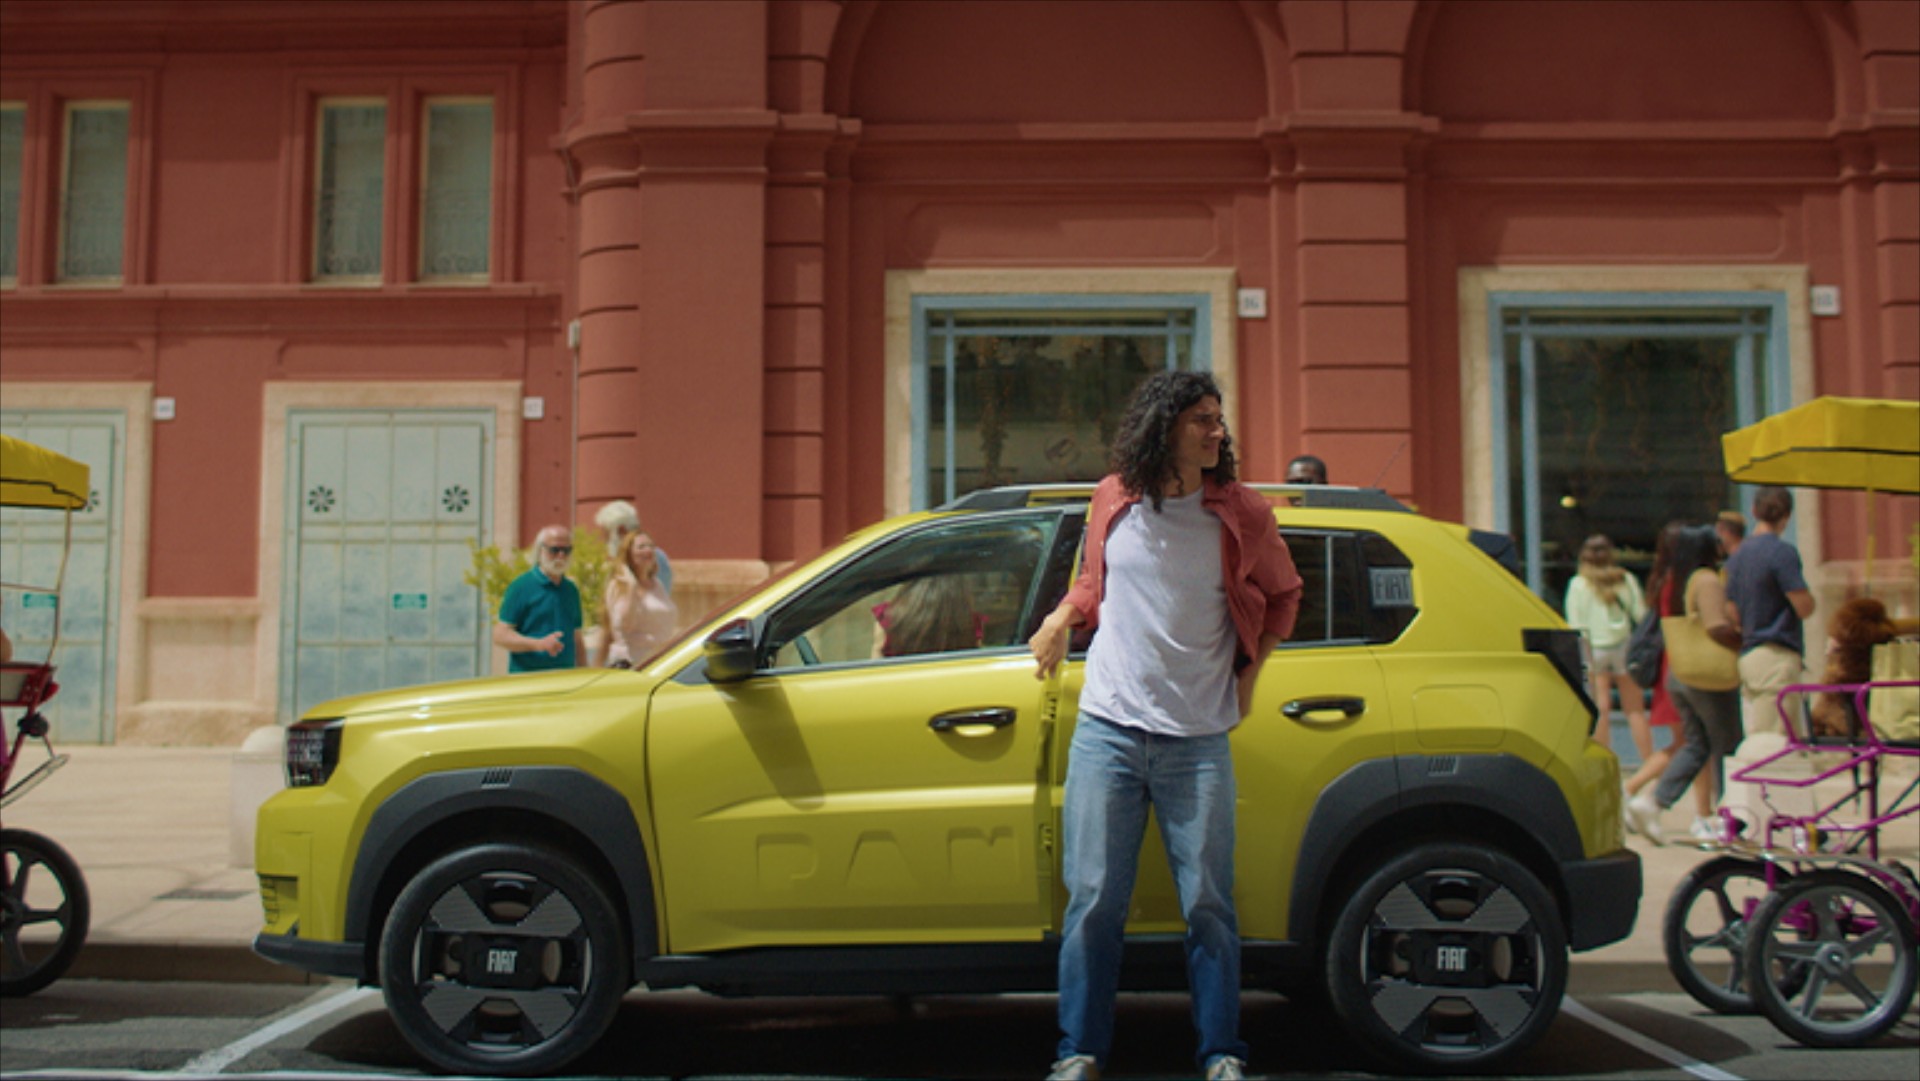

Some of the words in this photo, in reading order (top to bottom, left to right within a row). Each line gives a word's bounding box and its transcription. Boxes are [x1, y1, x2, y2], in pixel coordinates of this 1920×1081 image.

[1374, 573, 1410, 600] FIAT
[487, 949, 518, 974] FIAT
[1437, 946, 1467, 971] FIAT
